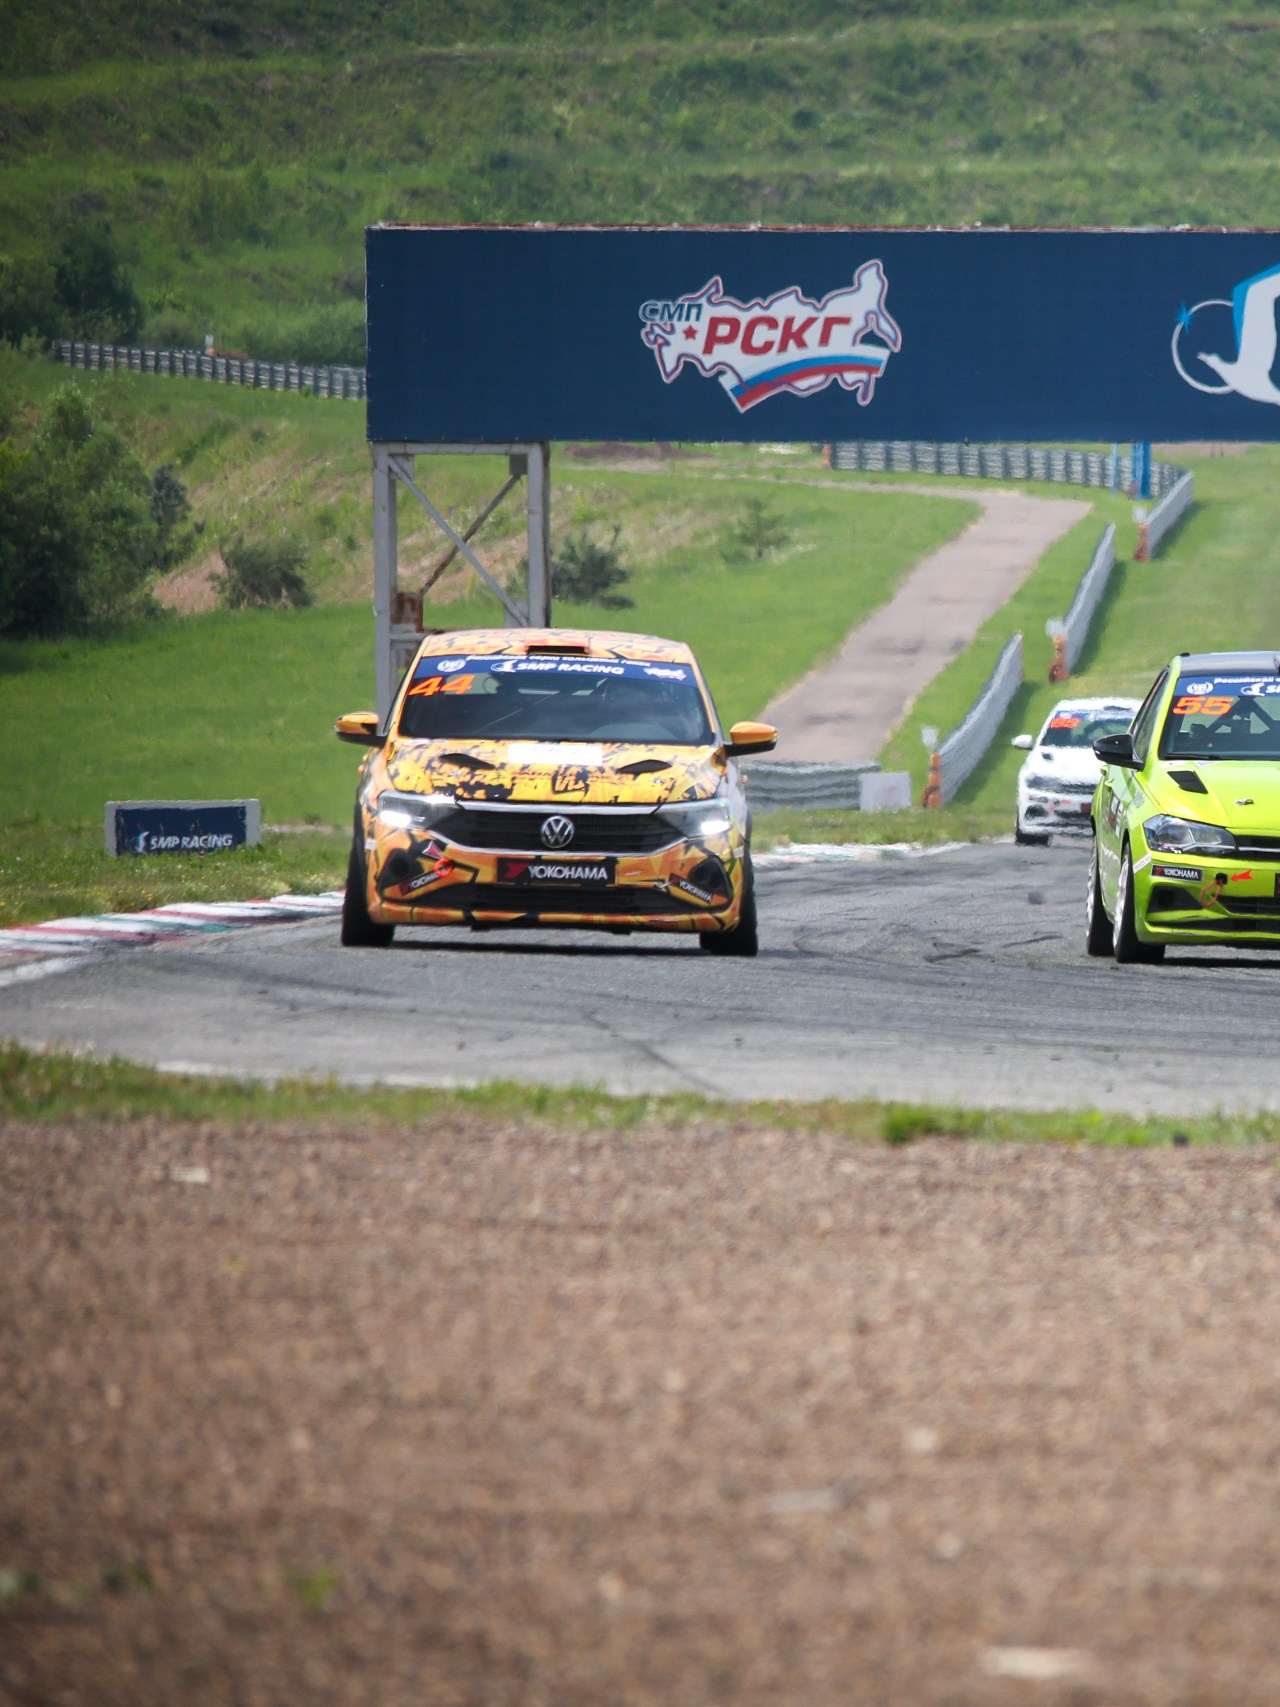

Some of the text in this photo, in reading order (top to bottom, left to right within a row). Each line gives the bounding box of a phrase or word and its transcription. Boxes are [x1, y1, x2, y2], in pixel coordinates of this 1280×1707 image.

[639, 301, 703, 323] СМП
[702, 315, 851, 356] РСКГ
[516, 662, 625, 675] SMP RACING
[408, 674, 475, 696] 44
[1172, 696, 1235, 715] 55
[151, 834, 233, 850] SMP RACING
[528, 864, 608, 880] YOKOHAMA
[1164, 867, 1199, 879] YOKOHAMA
